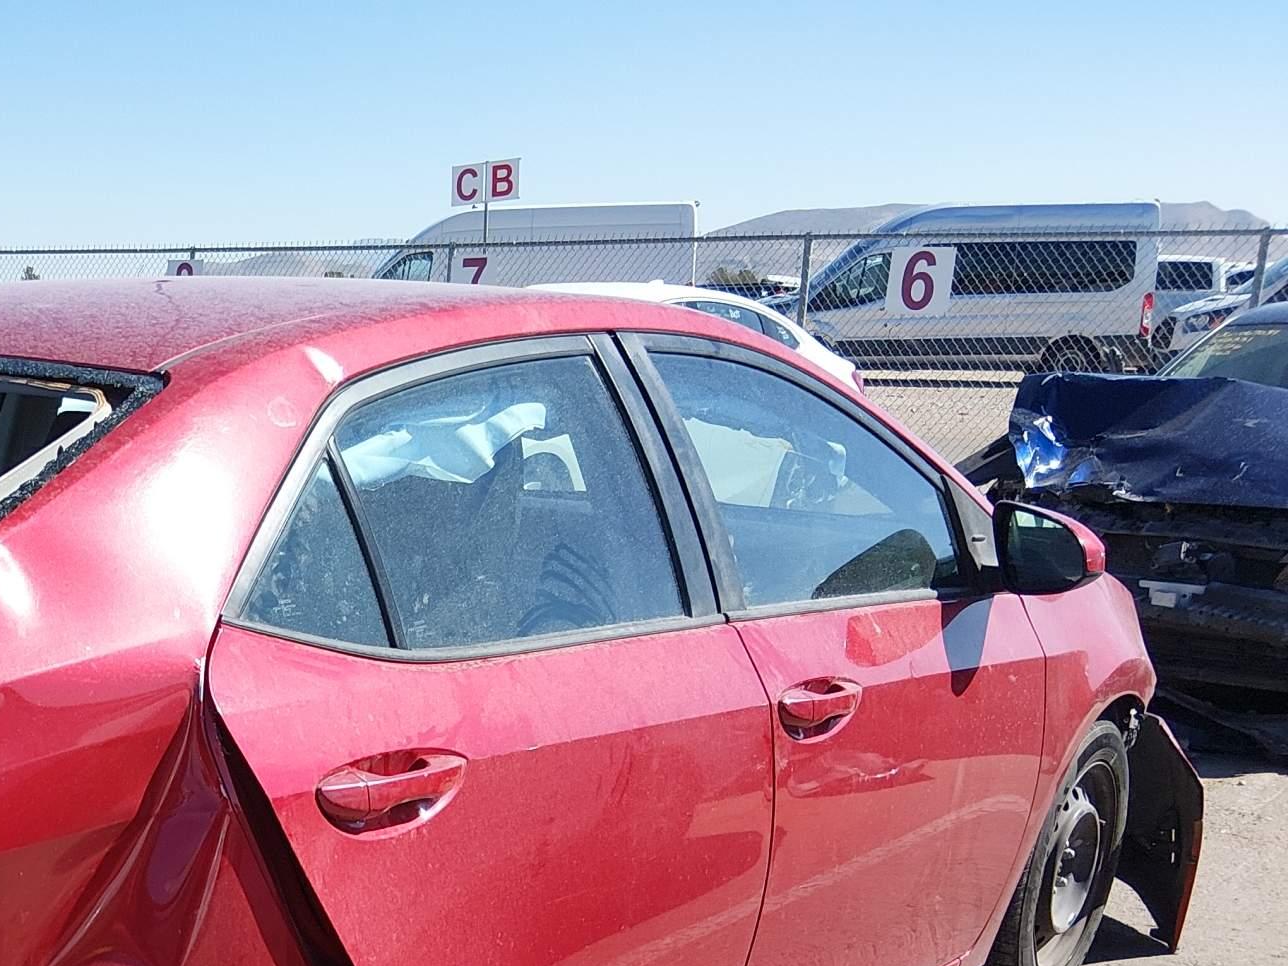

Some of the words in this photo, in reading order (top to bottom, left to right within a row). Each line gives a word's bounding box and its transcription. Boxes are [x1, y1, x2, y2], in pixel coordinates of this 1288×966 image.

[456, 168, 478, 202] C
[491, 164, 514, 198] B
[901, 250, 937, 311] 6
